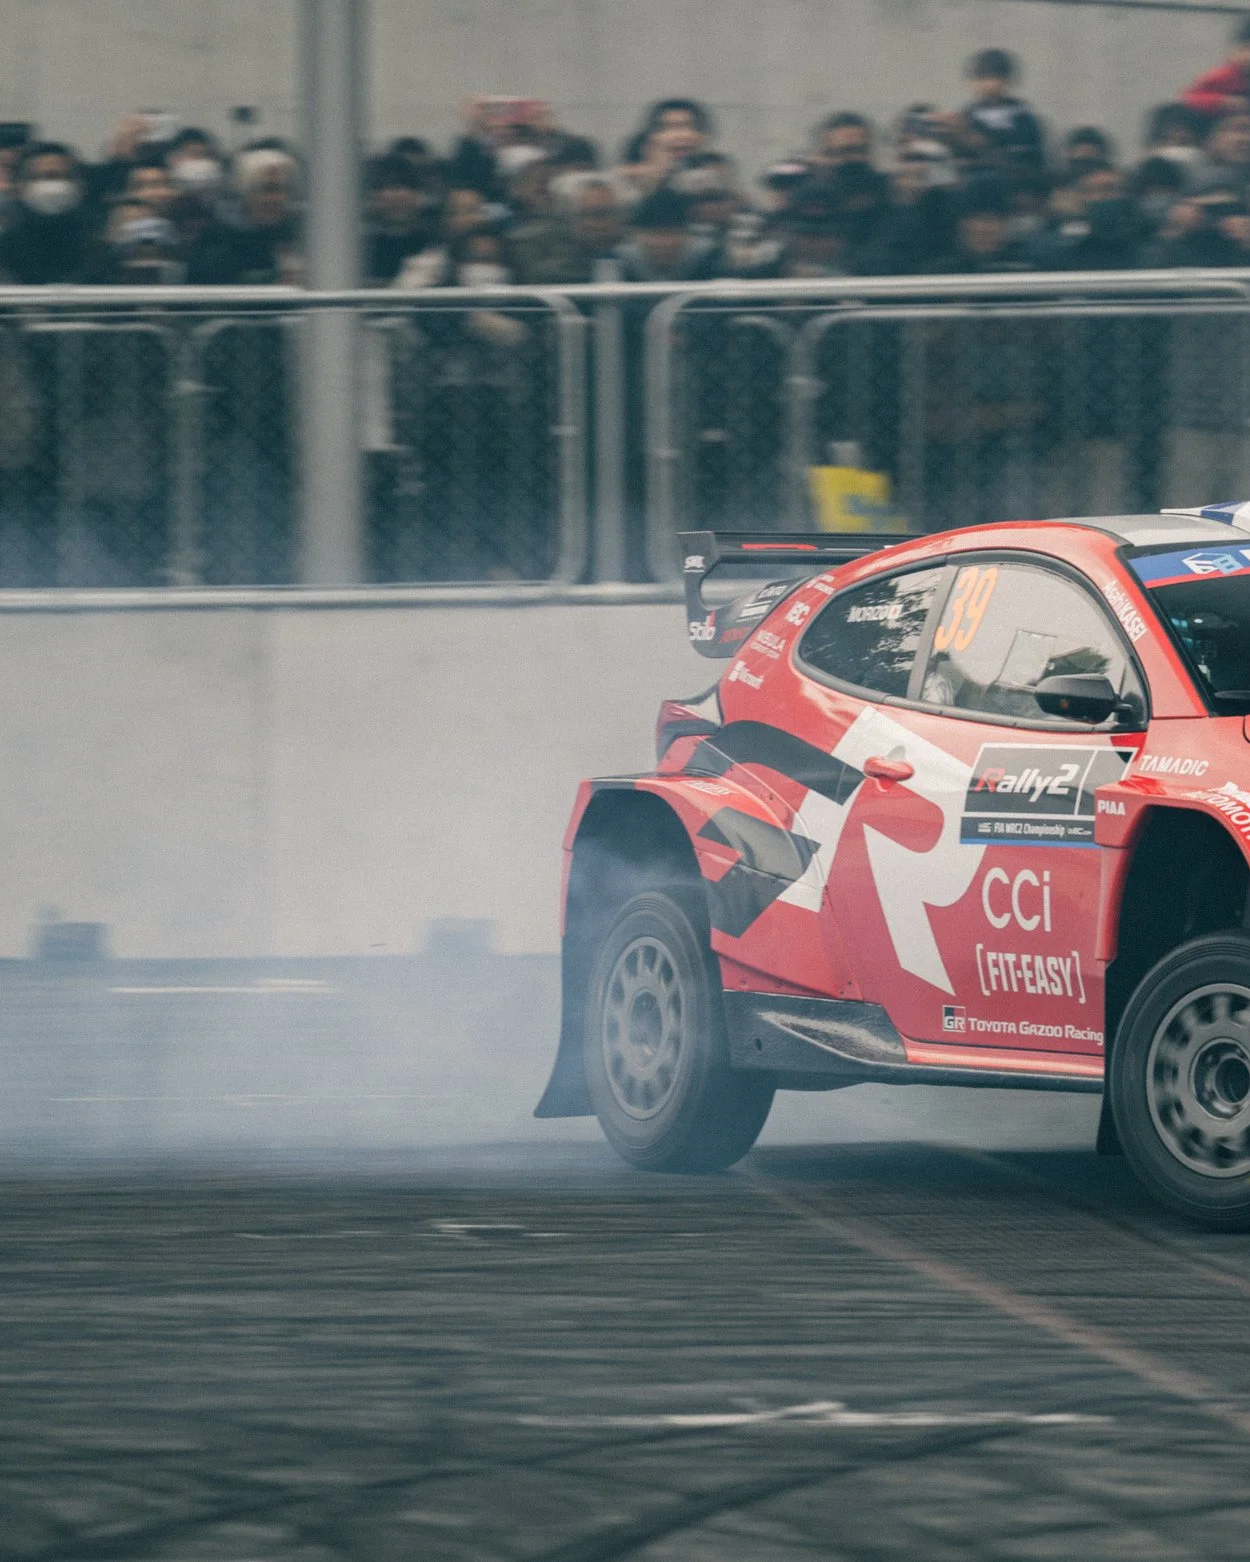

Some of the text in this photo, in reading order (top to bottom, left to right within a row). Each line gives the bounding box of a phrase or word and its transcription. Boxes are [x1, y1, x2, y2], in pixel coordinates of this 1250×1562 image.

[935, 567, 998, 652] 39
[1141, 754, 1210, 777] TAMADIC
[974, 763, 1080, 803] Rally2
[1097, 800, 1127, 817] PIAA
[967, 1017, 1017, 1034] TOYOTA
[1019, 1020, 1063, 1038] GAZOO
[1065, 1024, 1105, 1047] Racing
